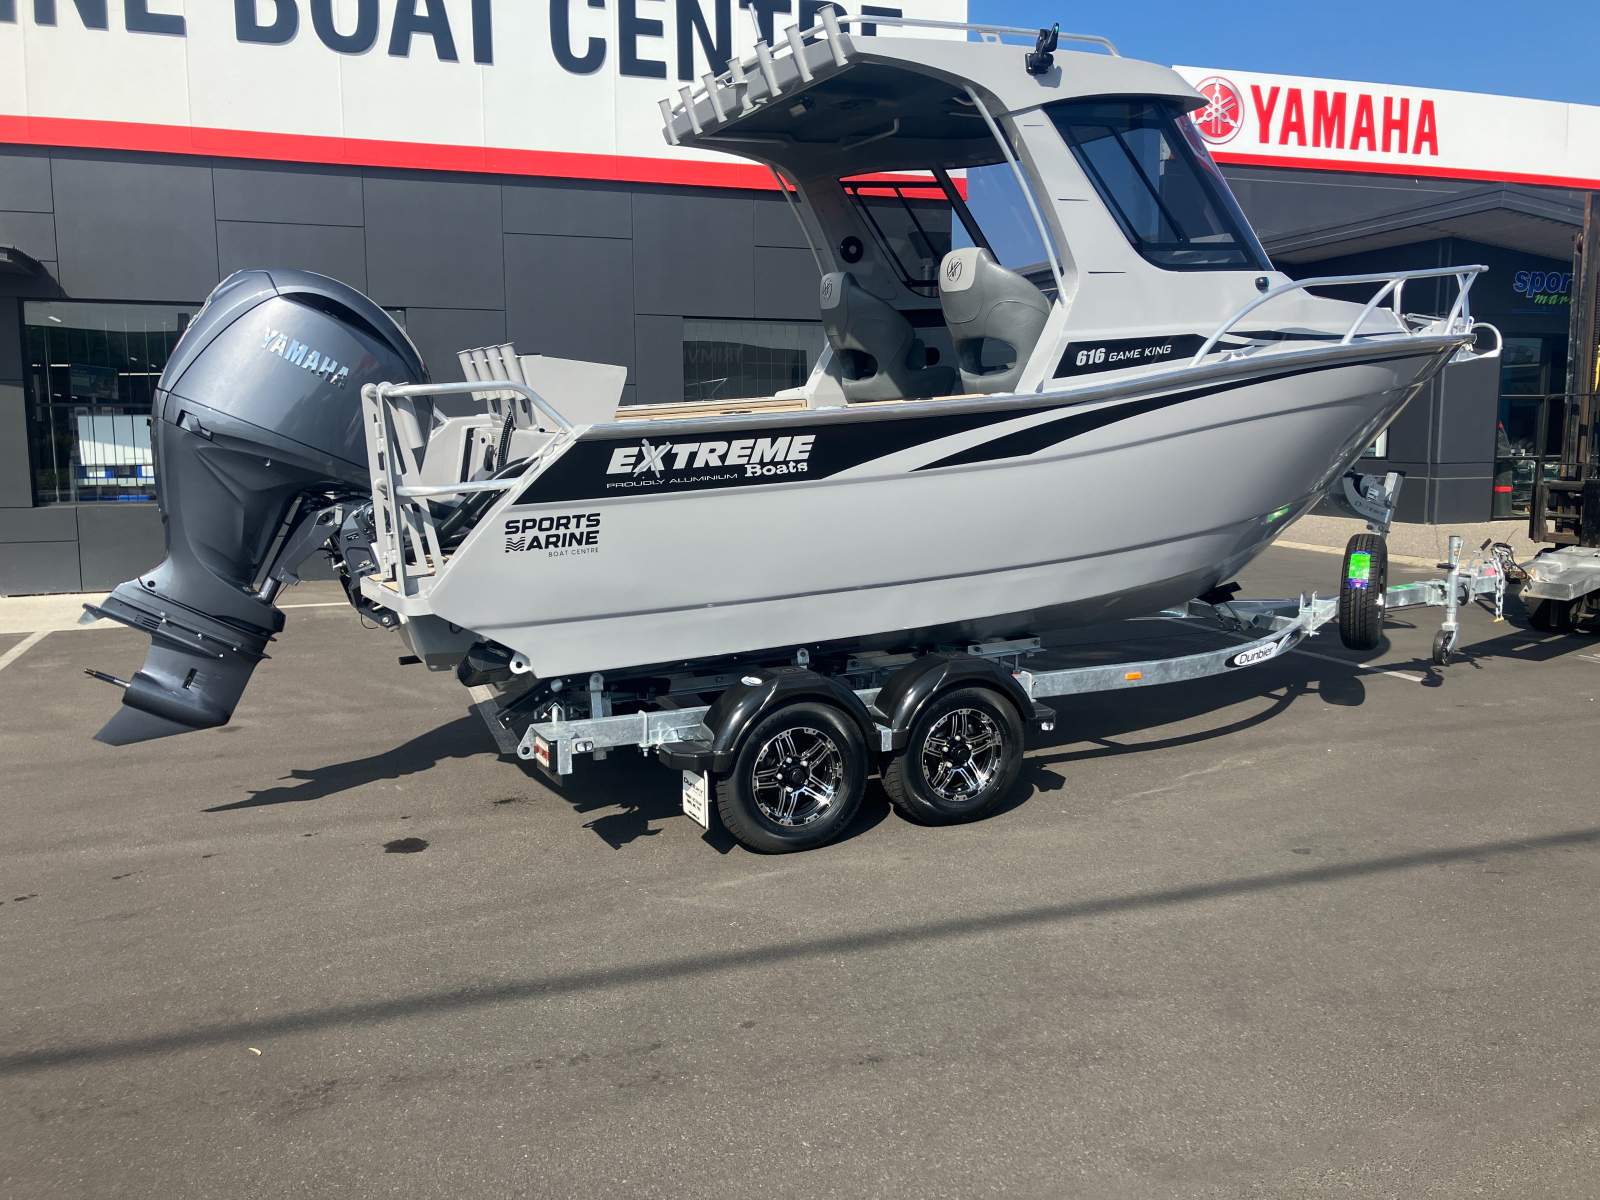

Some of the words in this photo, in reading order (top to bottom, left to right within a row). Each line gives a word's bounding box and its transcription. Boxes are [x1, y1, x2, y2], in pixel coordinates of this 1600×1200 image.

[1250, 84, 1439, 156] YAMAHA
[1512, 270, 1574, 298] spor
[261, 327, 350, 389] YAMAHA
[1075, 347, 1106, 367] 616
[1108, 348, 1142, 362] GAME
[1144, 344, 1172, 357] KING
[606, 434, 816, 478] EXTREME
[606, 479, 665, 489] PROUDLY
[669, 473, 738, 484] ALUMINIUM
[744, 462, 808, 477] Boats
[504, 512, 601, 535] SPORTS
[504, 529, 600, 553] MARINE
[548, 549, 568, 558] BOAT
[571, 546, 599, 555] CENTRE
[1239, 646, 1273, 664] Dunbier
